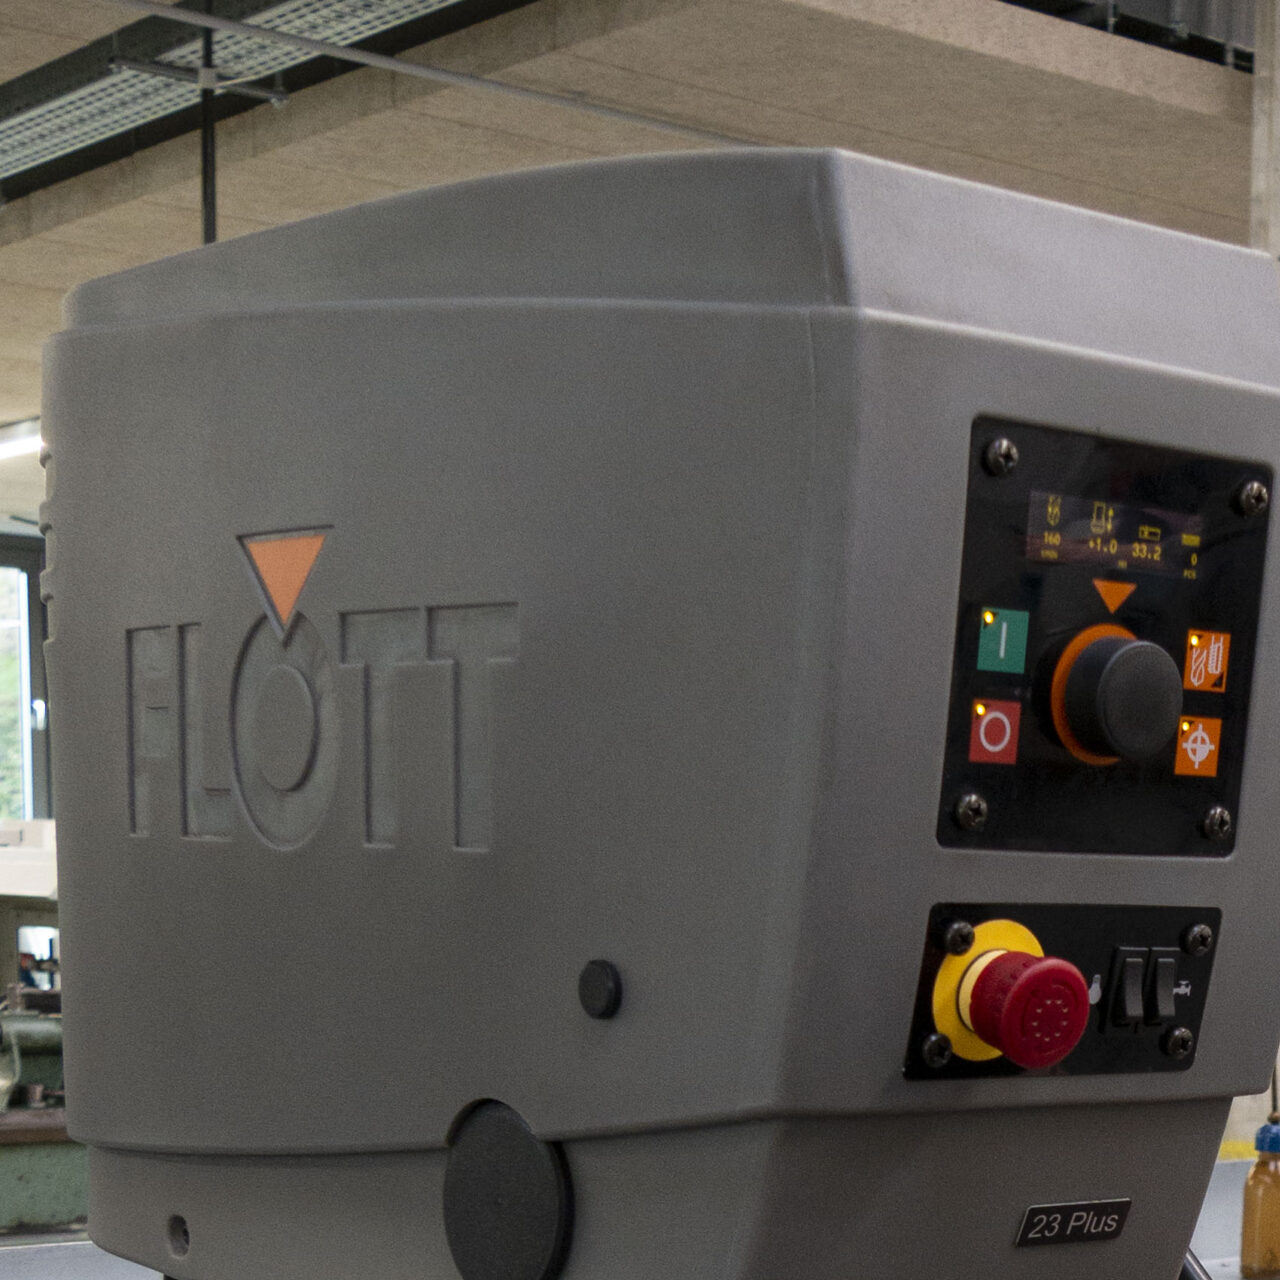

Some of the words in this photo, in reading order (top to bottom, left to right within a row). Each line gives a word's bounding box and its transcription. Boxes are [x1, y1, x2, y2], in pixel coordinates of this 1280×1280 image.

[1132, 542, 1162, 561] 33.2
[1028, 1213, 1062, 1239] 23
[1066, 1211, 1119, 1236] Plus
